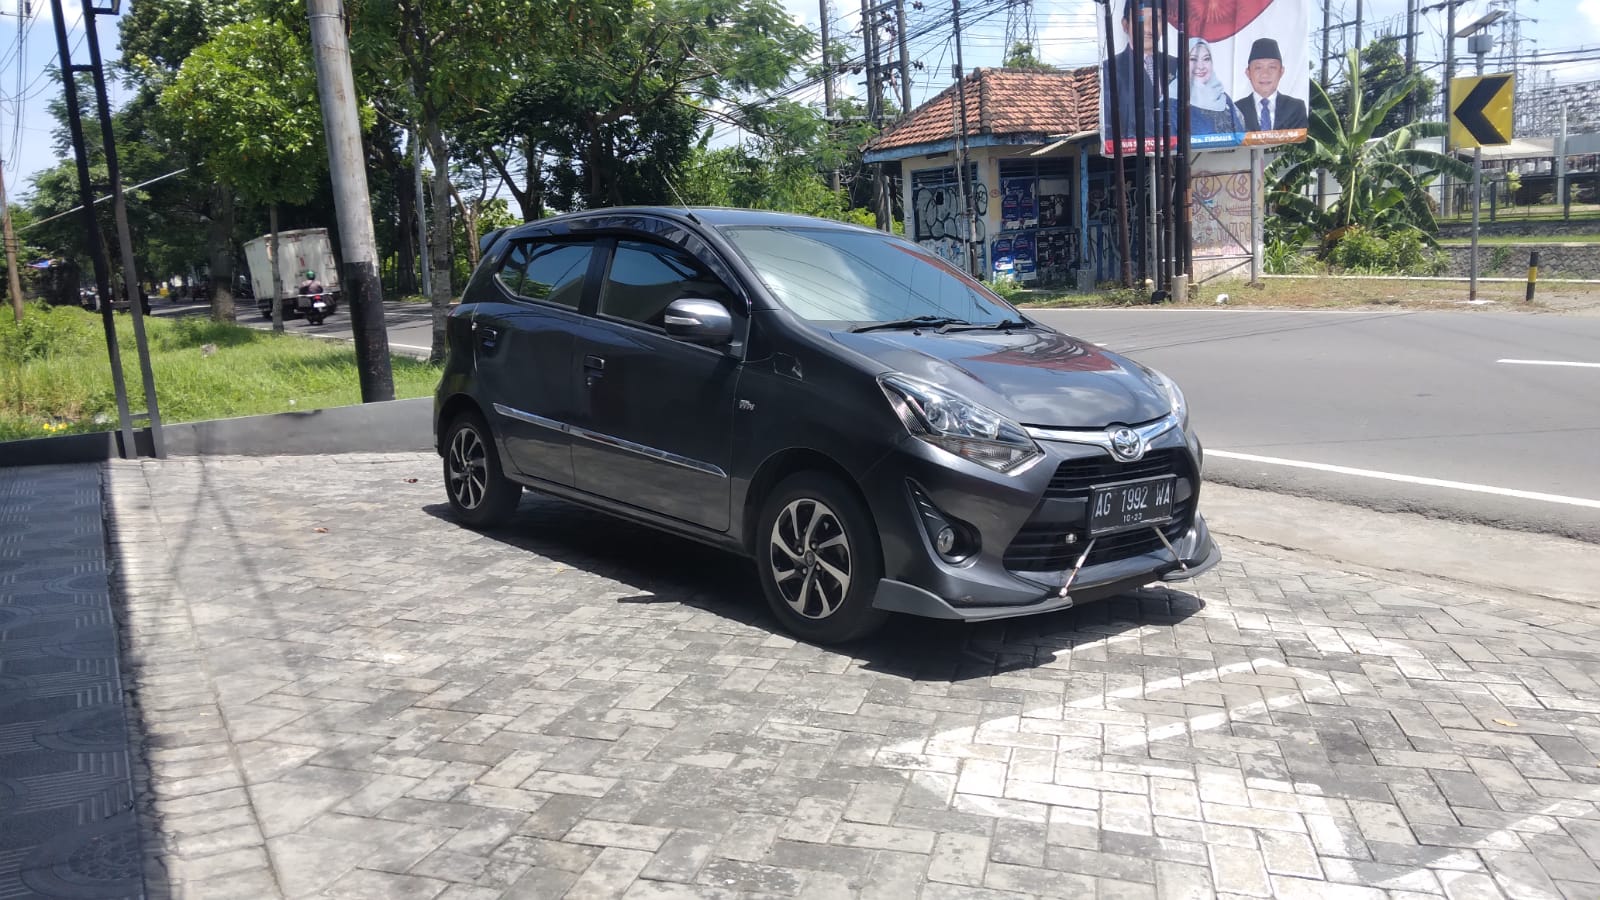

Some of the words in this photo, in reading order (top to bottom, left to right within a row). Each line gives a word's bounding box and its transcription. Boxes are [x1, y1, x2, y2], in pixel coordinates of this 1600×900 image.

[1095, 492, 1112, 518] AG
[1121, 486, 1149, 512] 1992
[1155, 482, 1170, 506] WA
